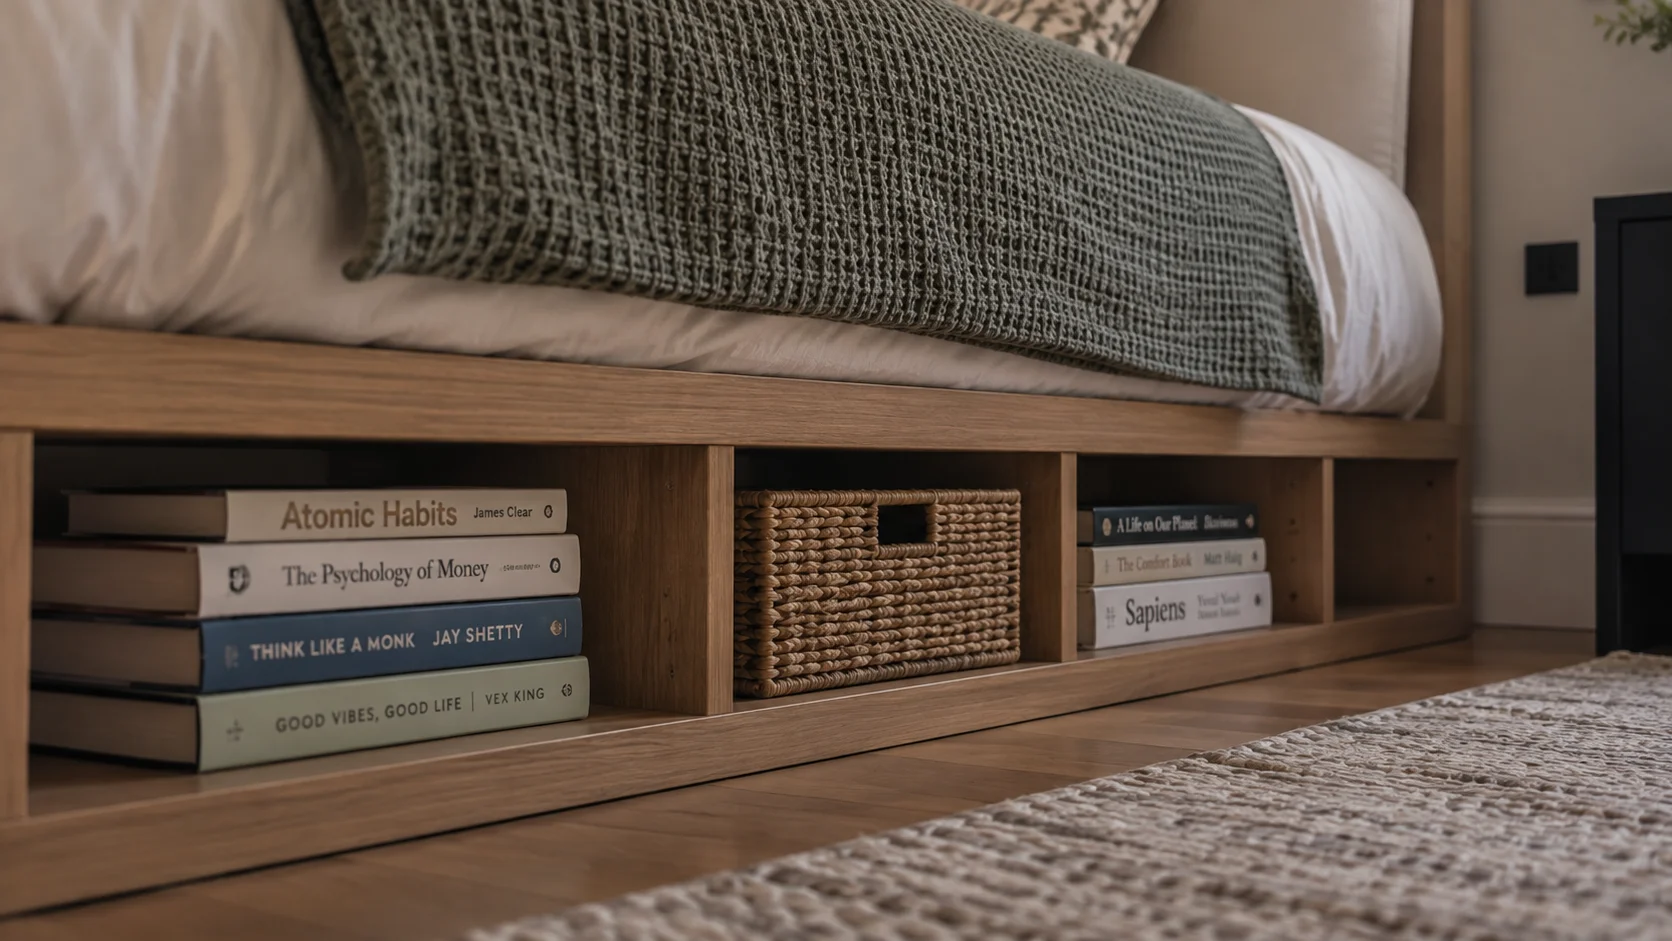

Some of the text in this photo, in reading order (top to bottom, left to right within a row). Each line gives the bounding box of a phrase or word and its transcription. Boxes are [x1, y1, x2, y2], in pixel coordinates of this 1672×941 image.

[281, 500, 458, 530] Atomic Habits
[473, 506, 533, 518] James Clear
[1117, 519, 1125, 533] A
[1126, 516, 1142, 532] Life
[1155, 515, 1171, 532] Our
[282, 558, 489, 590] The Psychology of Money
[1117, 552, 1192, 572] The Comfort Book
[1126, 597, 1186, 632] Sapiens
[250, 633, 415, 661] THINK LIKE A MONK
[432, 623, 524, 646] JAY SHETTY
[485, 687, 545, 705] VEX KING
[275, 697, 462, 733] GOOD VIBES, GOOD LIFE
